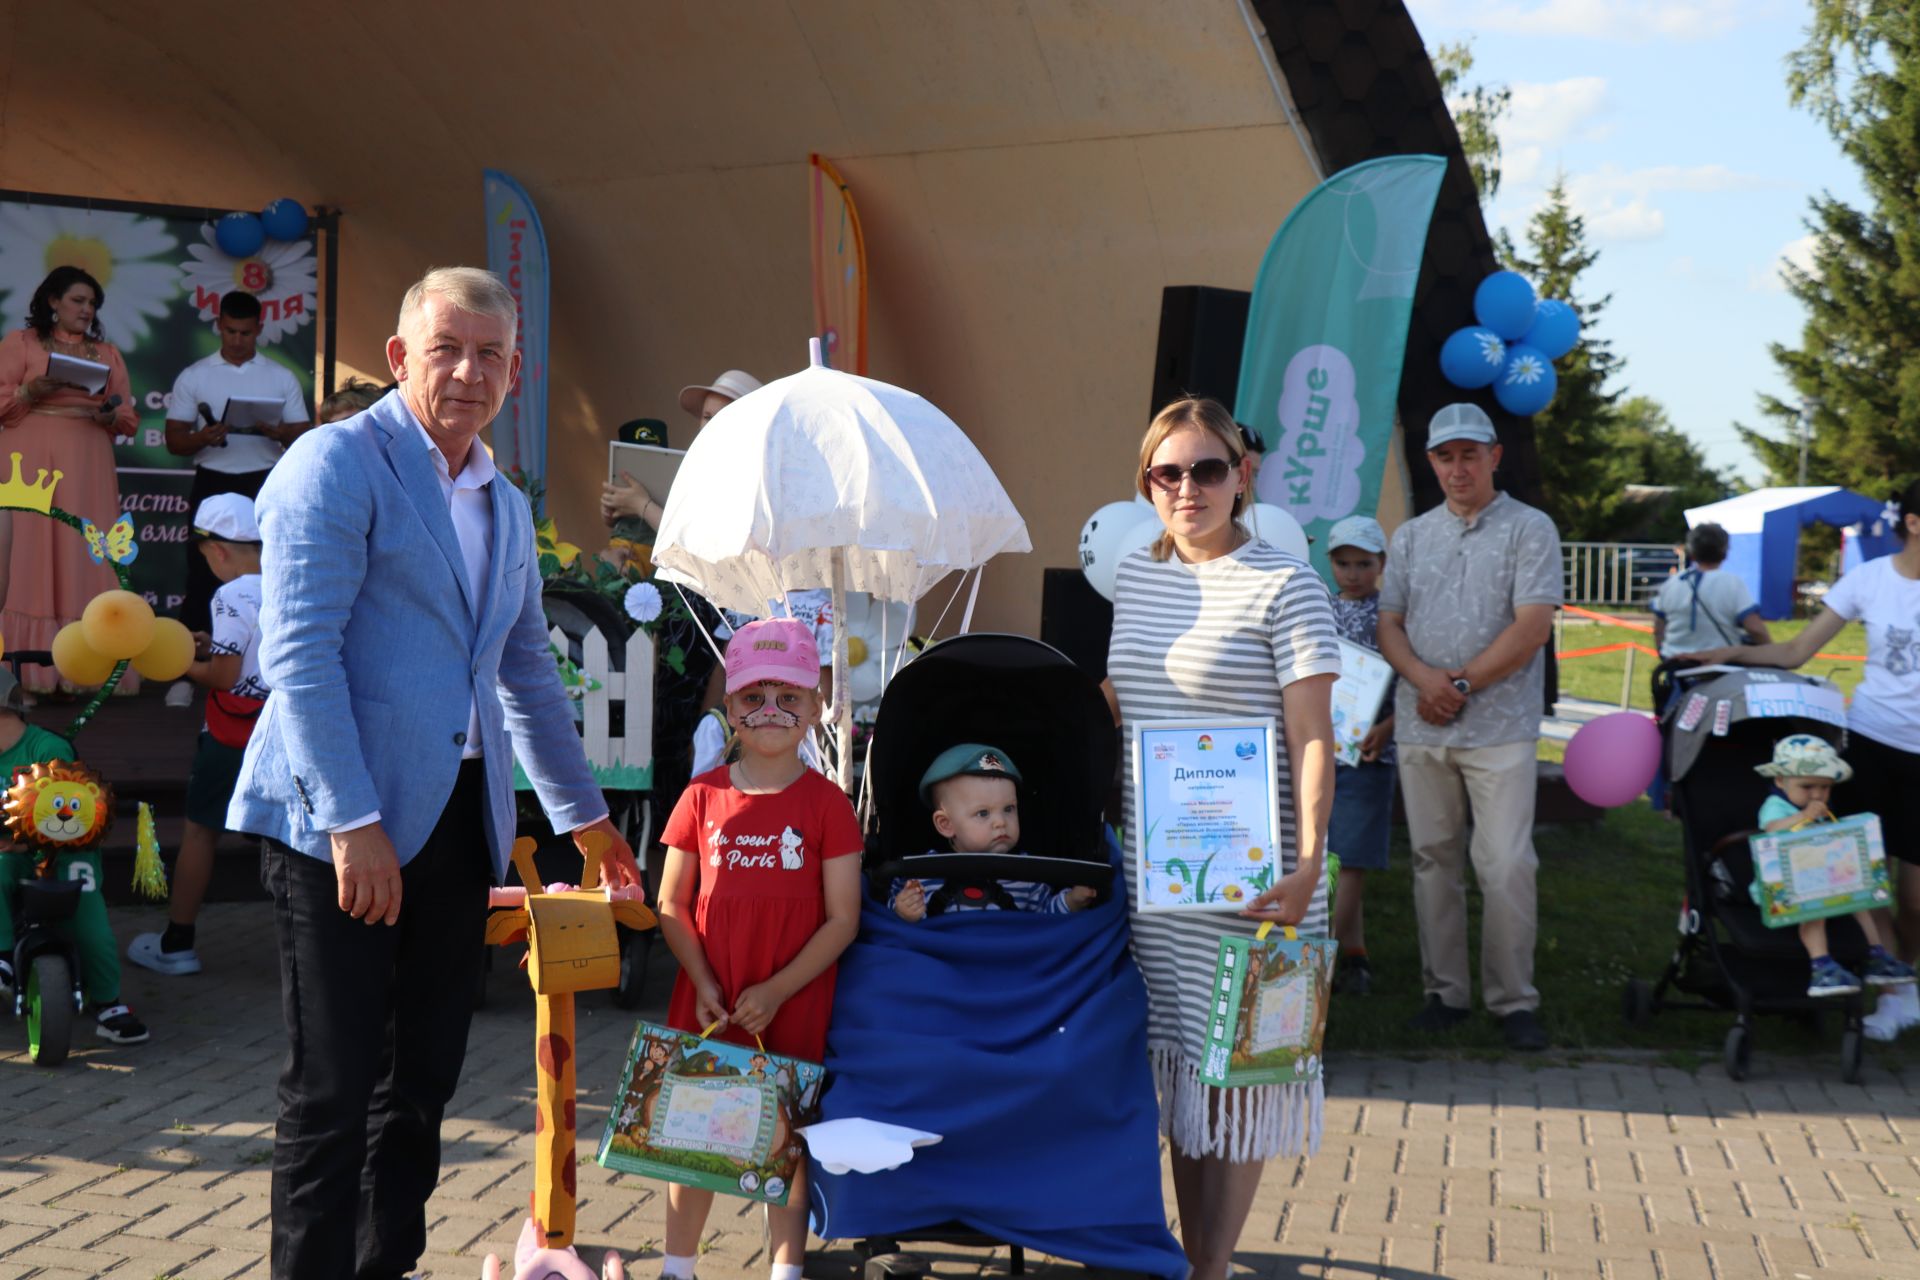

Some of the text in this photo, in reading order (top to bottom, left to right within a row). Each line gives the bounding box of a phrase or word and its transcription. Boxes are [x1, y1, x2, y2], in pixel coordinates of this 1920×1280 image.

[242, 262, 266, 289] 8
[1174, 767, 1237, 782] Диплом
[707, 827, 730, 849] Au
[709, 848, 776, 871] de Paris
